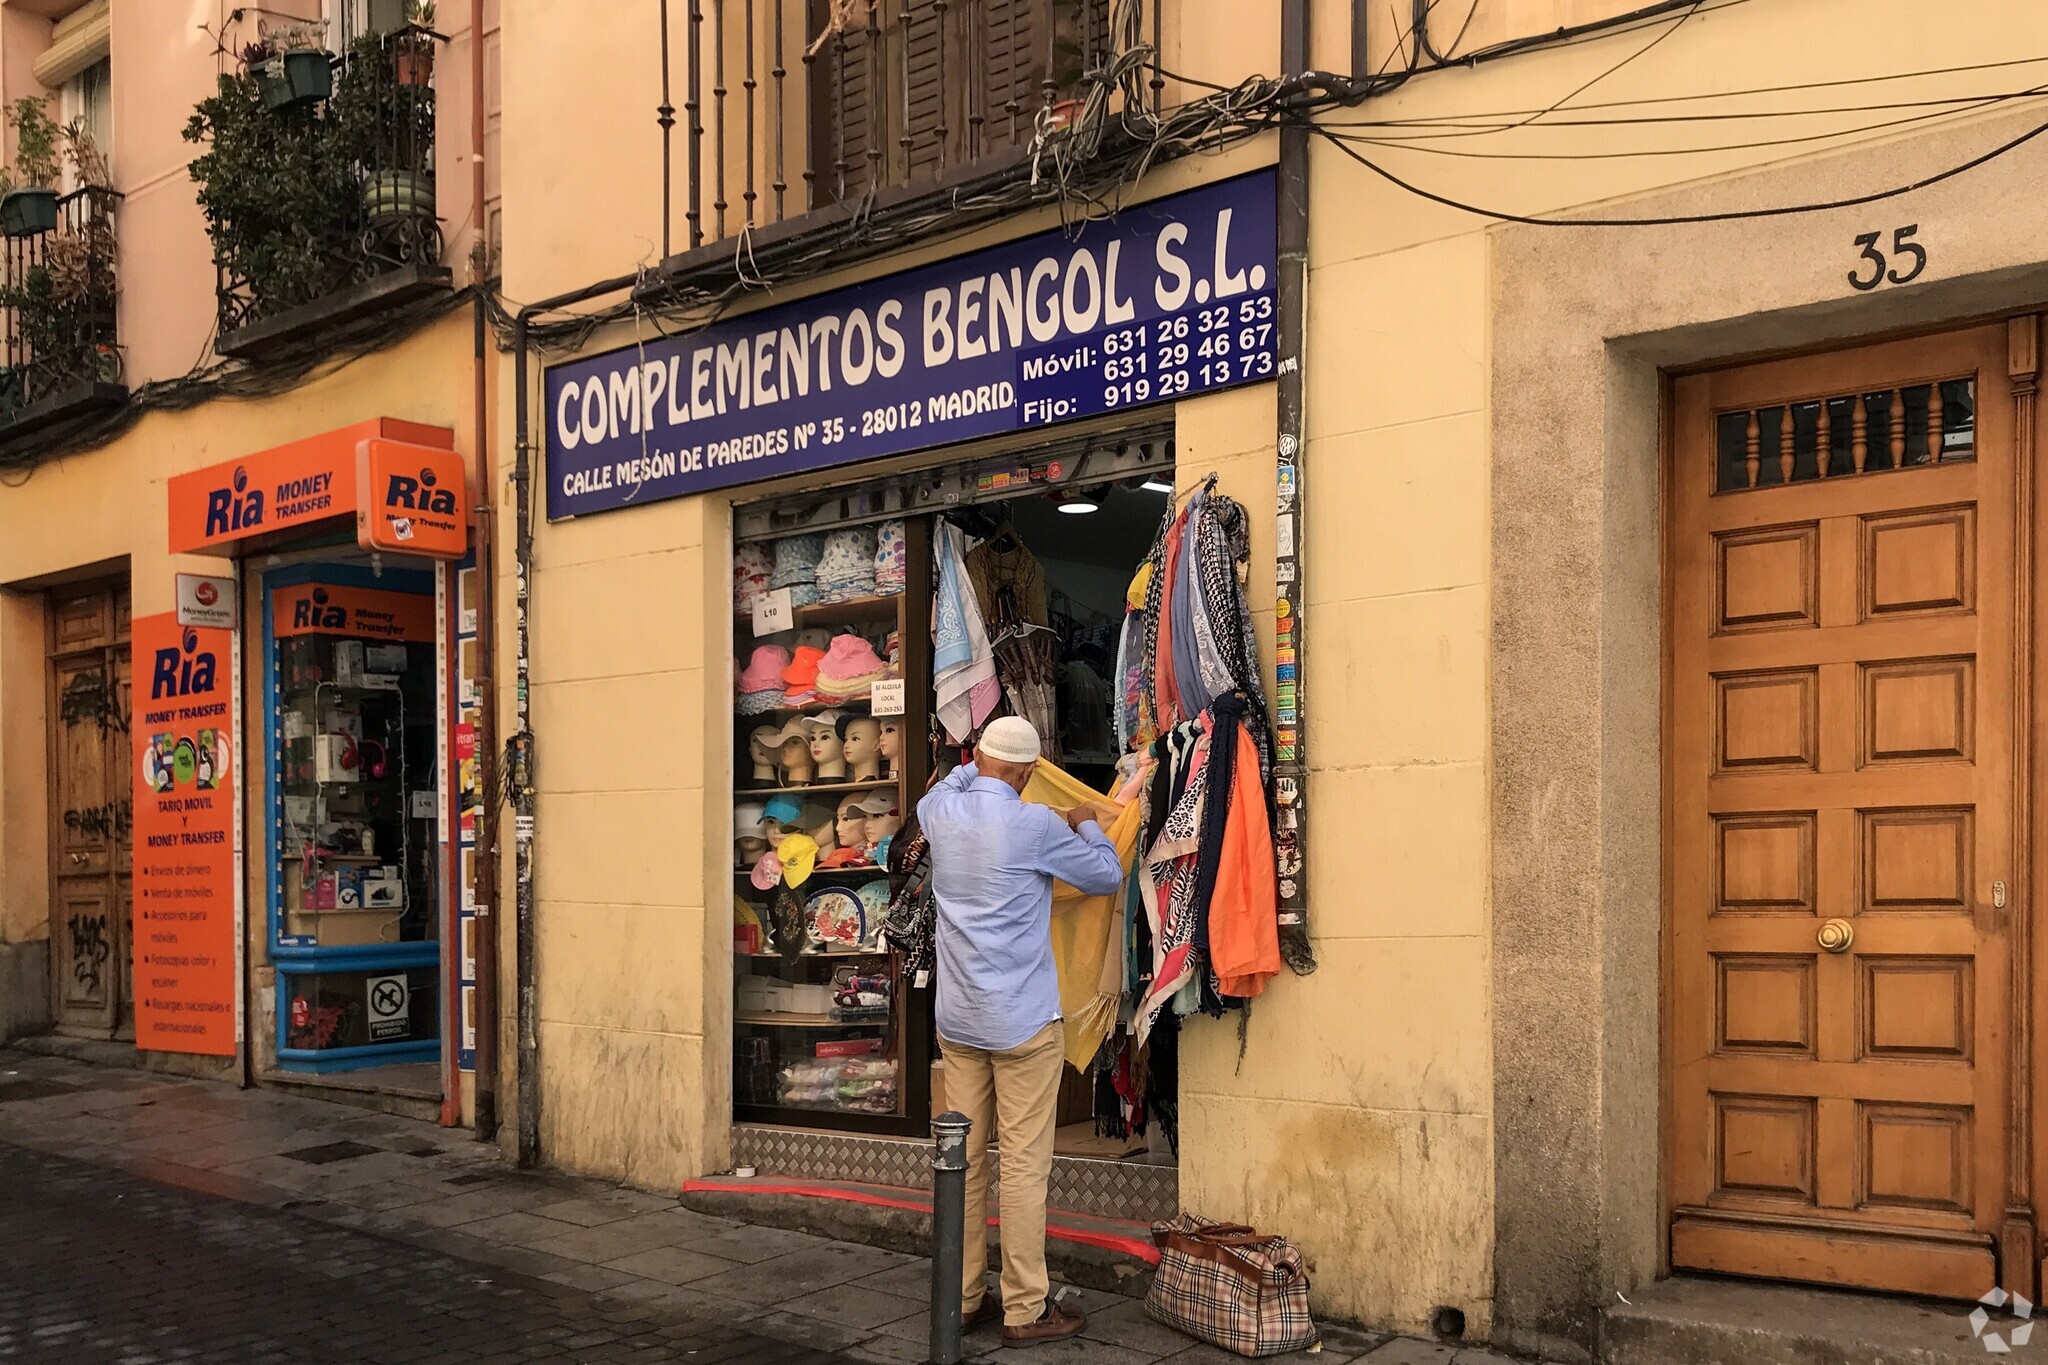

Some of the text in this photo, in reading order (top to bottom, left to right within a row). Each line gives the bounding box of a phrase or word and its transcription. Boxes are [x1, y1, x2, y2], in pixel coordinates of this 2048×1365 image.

[1847, 223, 1927, 291] 35
[557, 207, 1266, 450] COMPLEMENTOS BENGOL S.L.
[1022, 296, 1272, 381] Móvil: 631 26 32 53
[1103, 322, 1272, 381] 631 29 46 67
[1023, 397, 1077, 423] Fijo:
[1104, 379, 1150, 407] 919
[1158, 371, 1190, 396] 29
[1199, 361, 1230, 386] 13
[1239, 351, 1273, 377] 73
[563, 464, 612, 496] CALLE
[616, 449, 675, 485] MESÓN
[680, 446, 702, 473] DE
[707, 428, 788, 468] PAREDES
[794, 422, 816, 450] Nº
[821, 417, 844, 445] 35
[849, 425, 857, 434] -
[861, 400, 922, 437] 28012
[205, 465, 333, 538] Ria MONEY
[275, 494, 331, 519] TRANSFER
[386, 467, 456, 515] Ria
[386, 514, 456, 531] Moy Transfer
[293, 587, 395, 629] Ria Money
[355, 621, 405, 636] Transfer
[151, 625, 216, 700] Ria
[145, 702, 227, 724] MONEY TRANSFER
[158, 799, 182, 814] TARIQ
[182, 816, 188, 827] Y
[148, 830, 225, 848] MONEY TRANSFER
